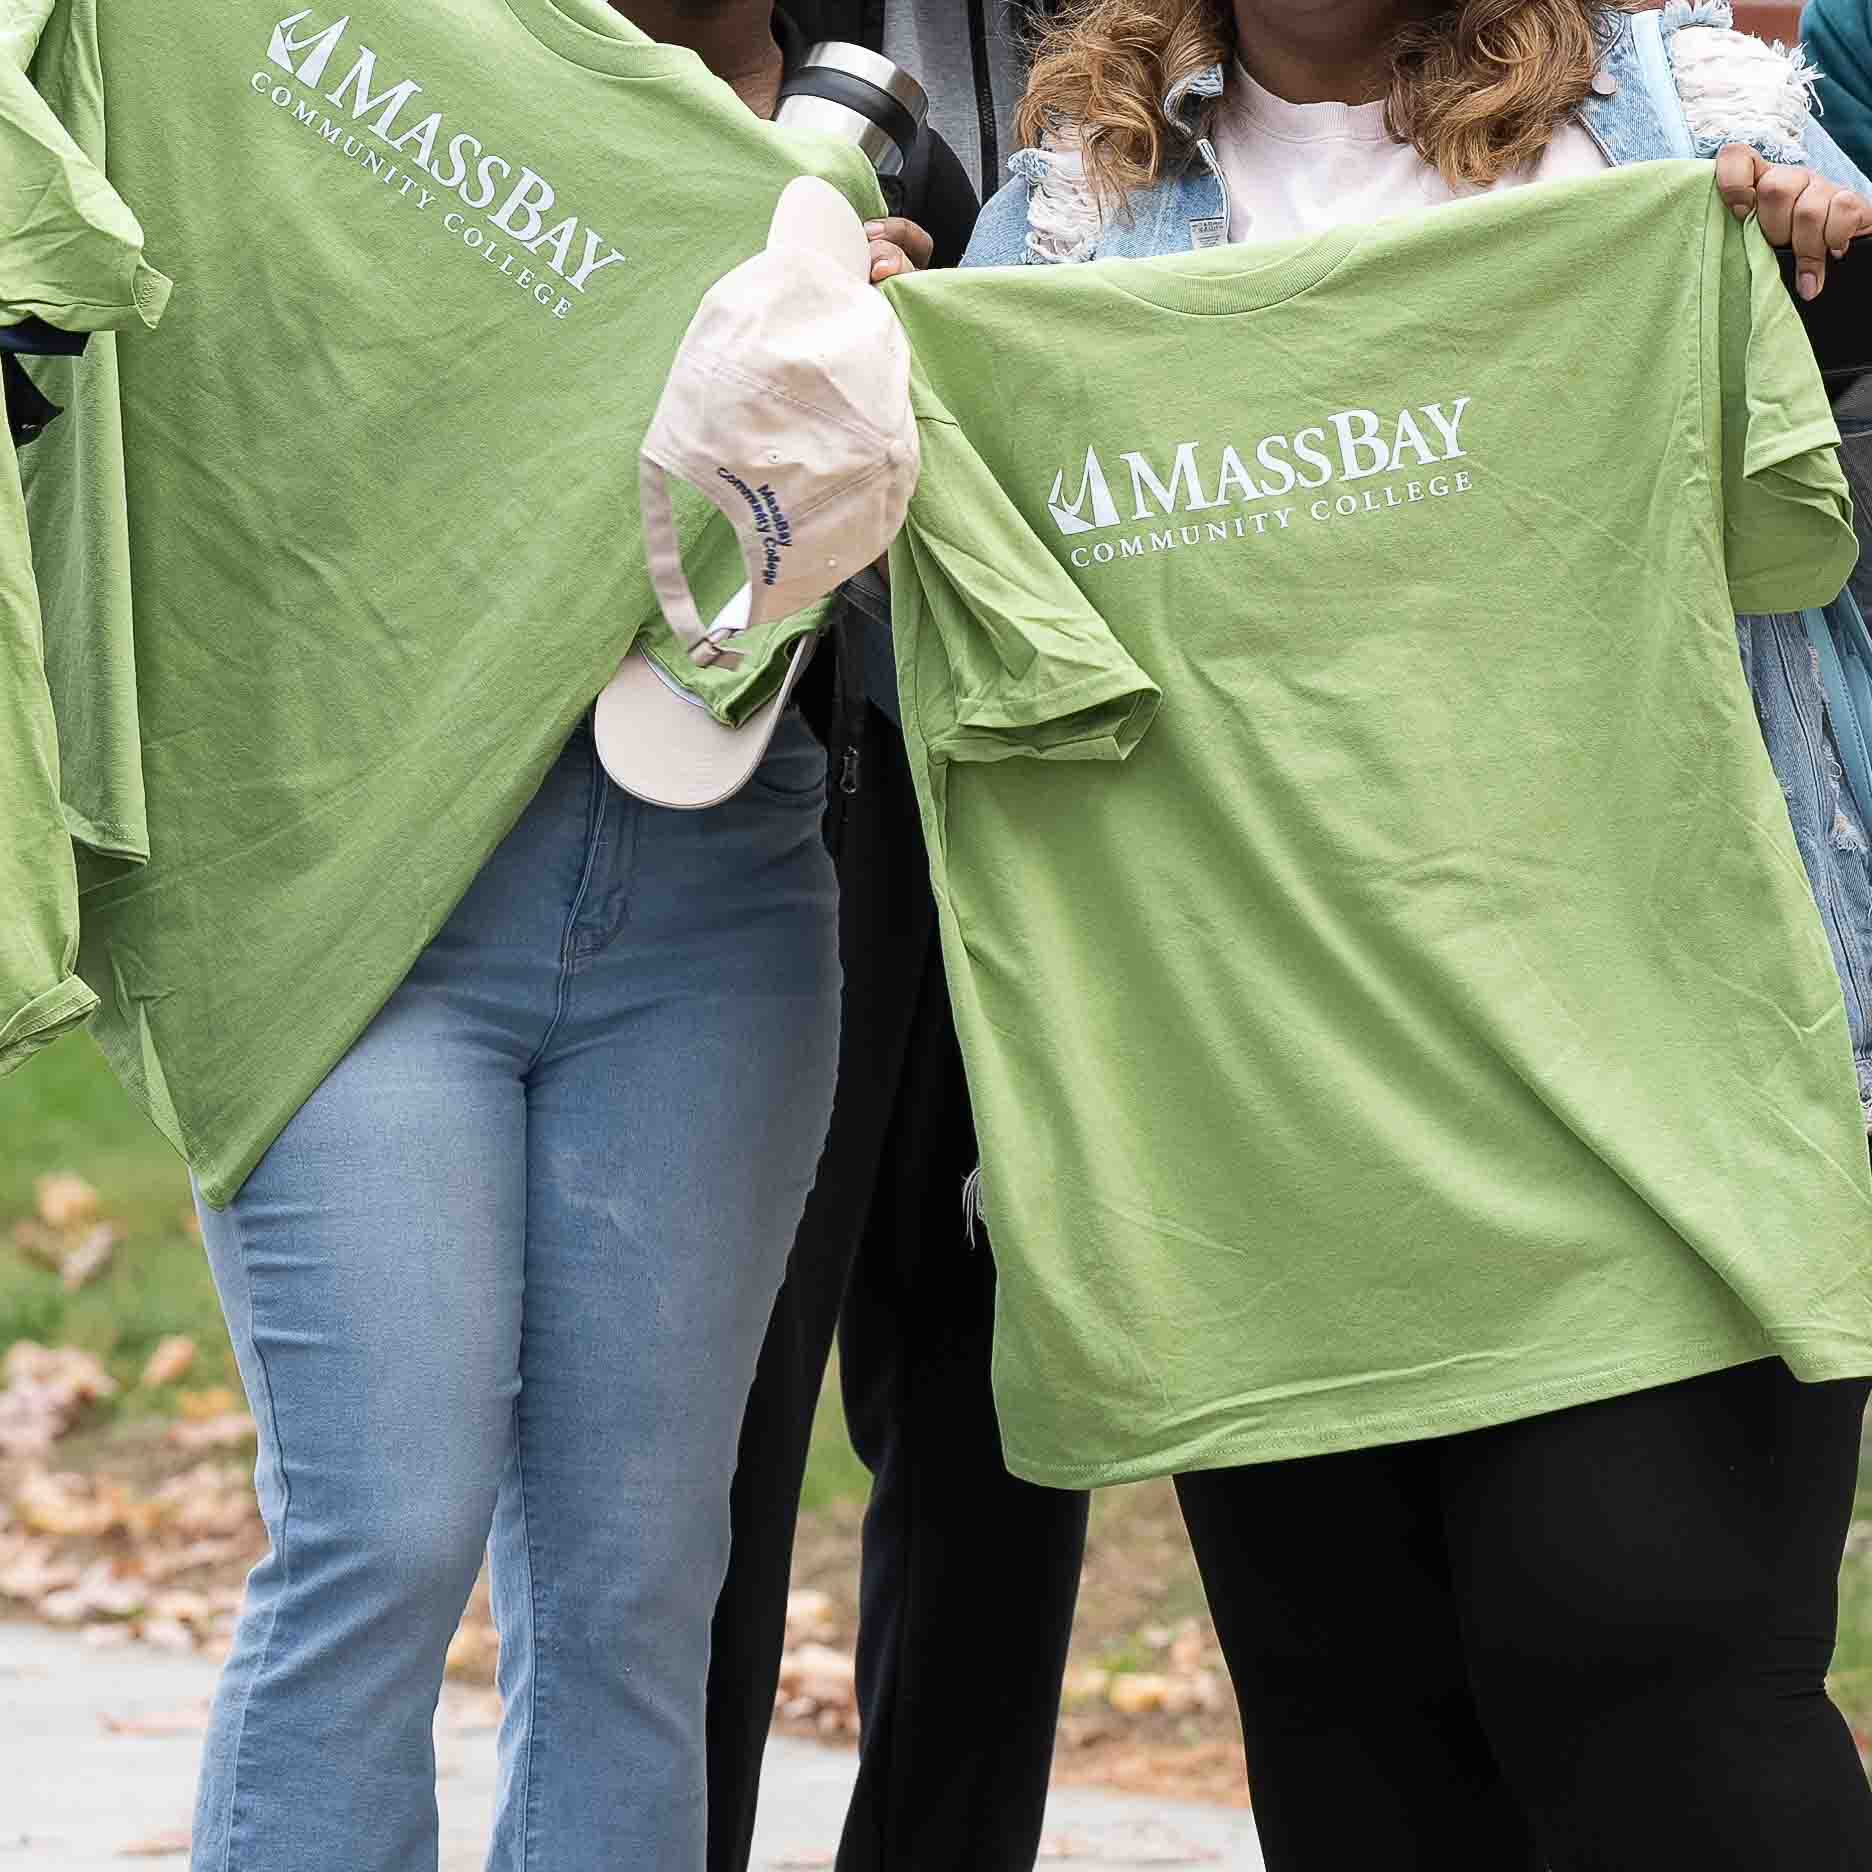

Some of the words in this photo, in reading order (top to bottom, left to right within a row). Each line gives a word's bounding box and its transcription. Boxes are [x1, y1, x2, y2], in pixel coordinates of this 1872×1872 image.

[251, 71, 436, 210] COMMUNITY
[443, 213, 573, 319] COLLEGE
[1070, 507, 1295, 568] COMMUNITY
[1311, 470, 1473, 521] COLLEGE
